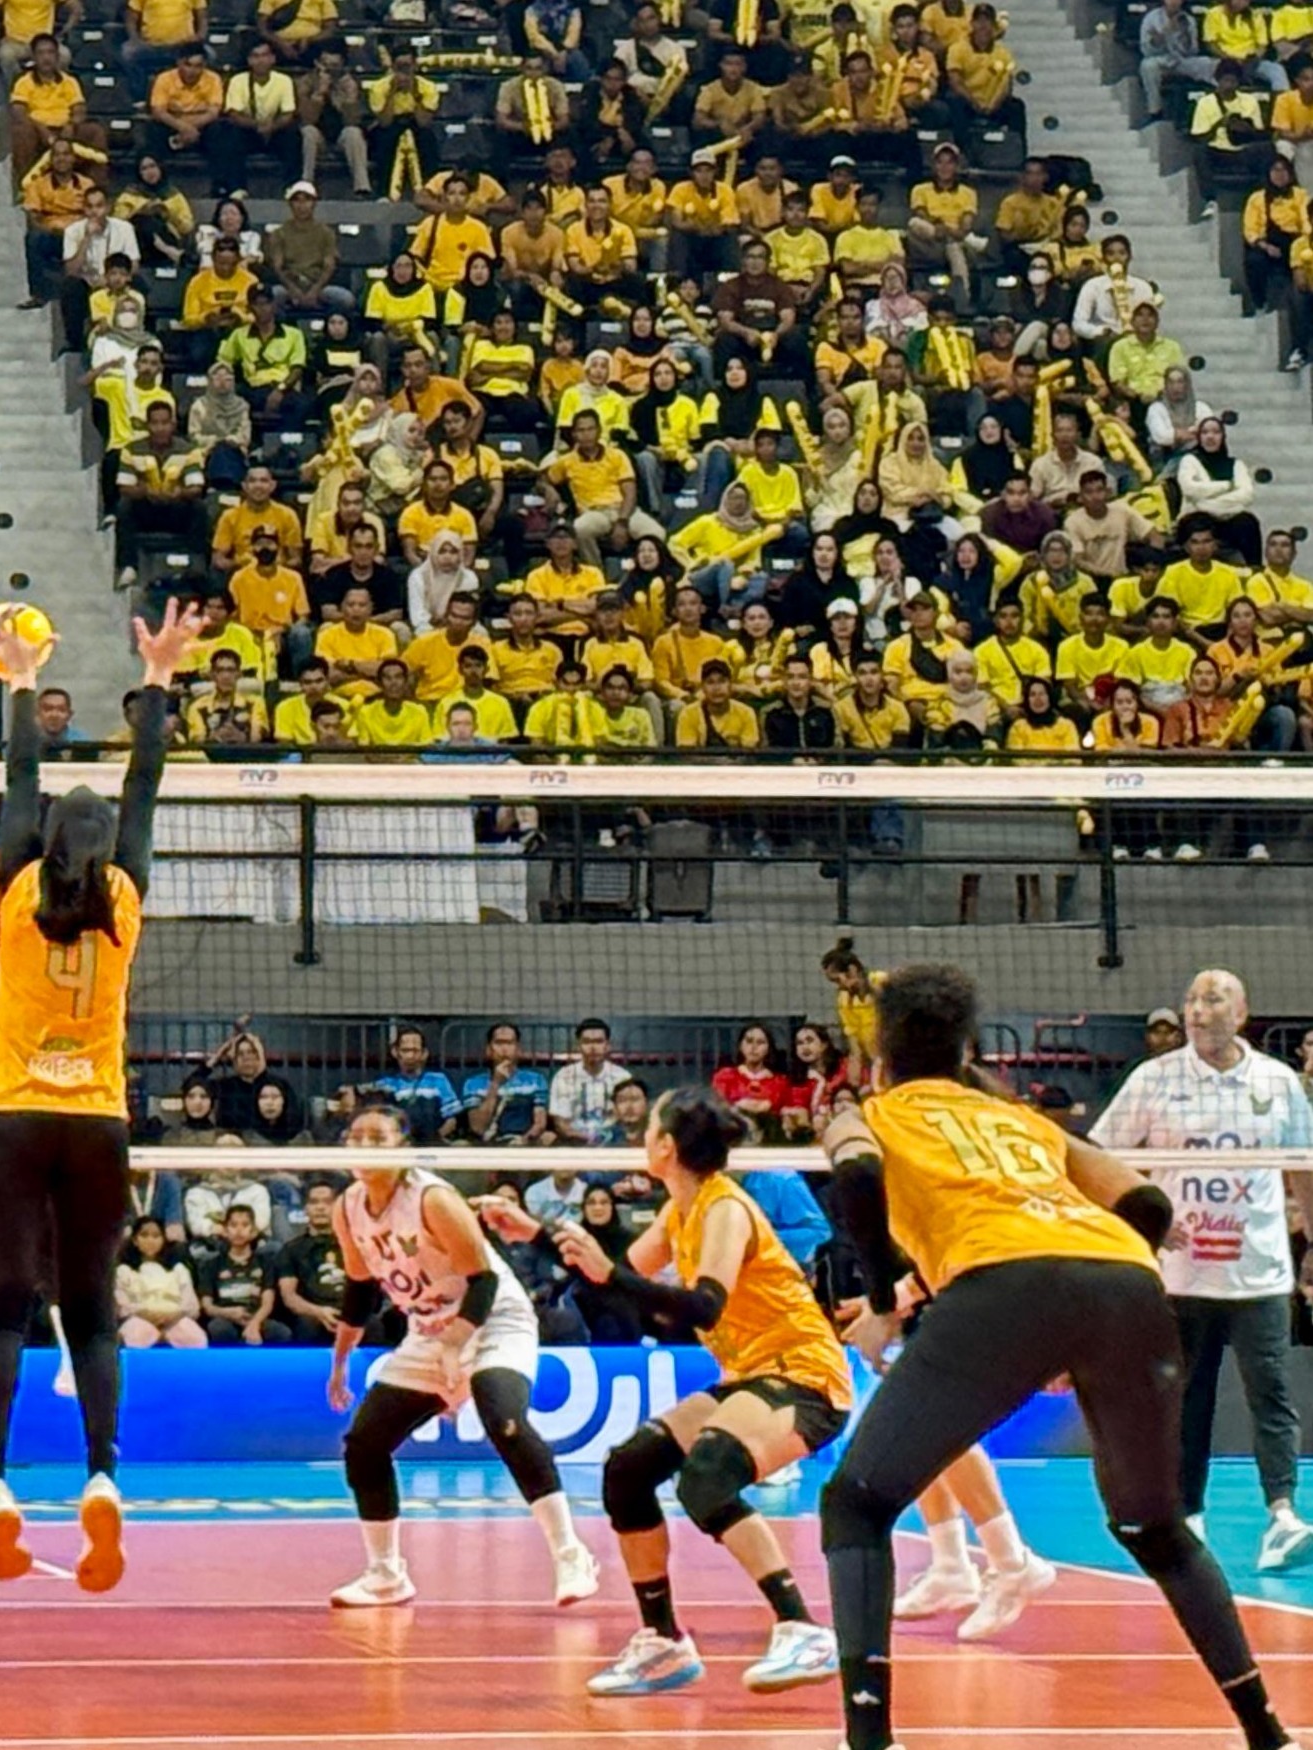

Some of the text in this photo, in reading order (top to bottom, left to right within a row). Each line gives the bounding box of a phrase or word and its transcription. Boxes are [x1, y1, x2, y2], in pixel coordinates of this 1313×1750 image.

[47, 930, 97, 1020] 4
[922, 1108, 1059, 1187] 16
[1181, 1176, 1255, 1204] nex
